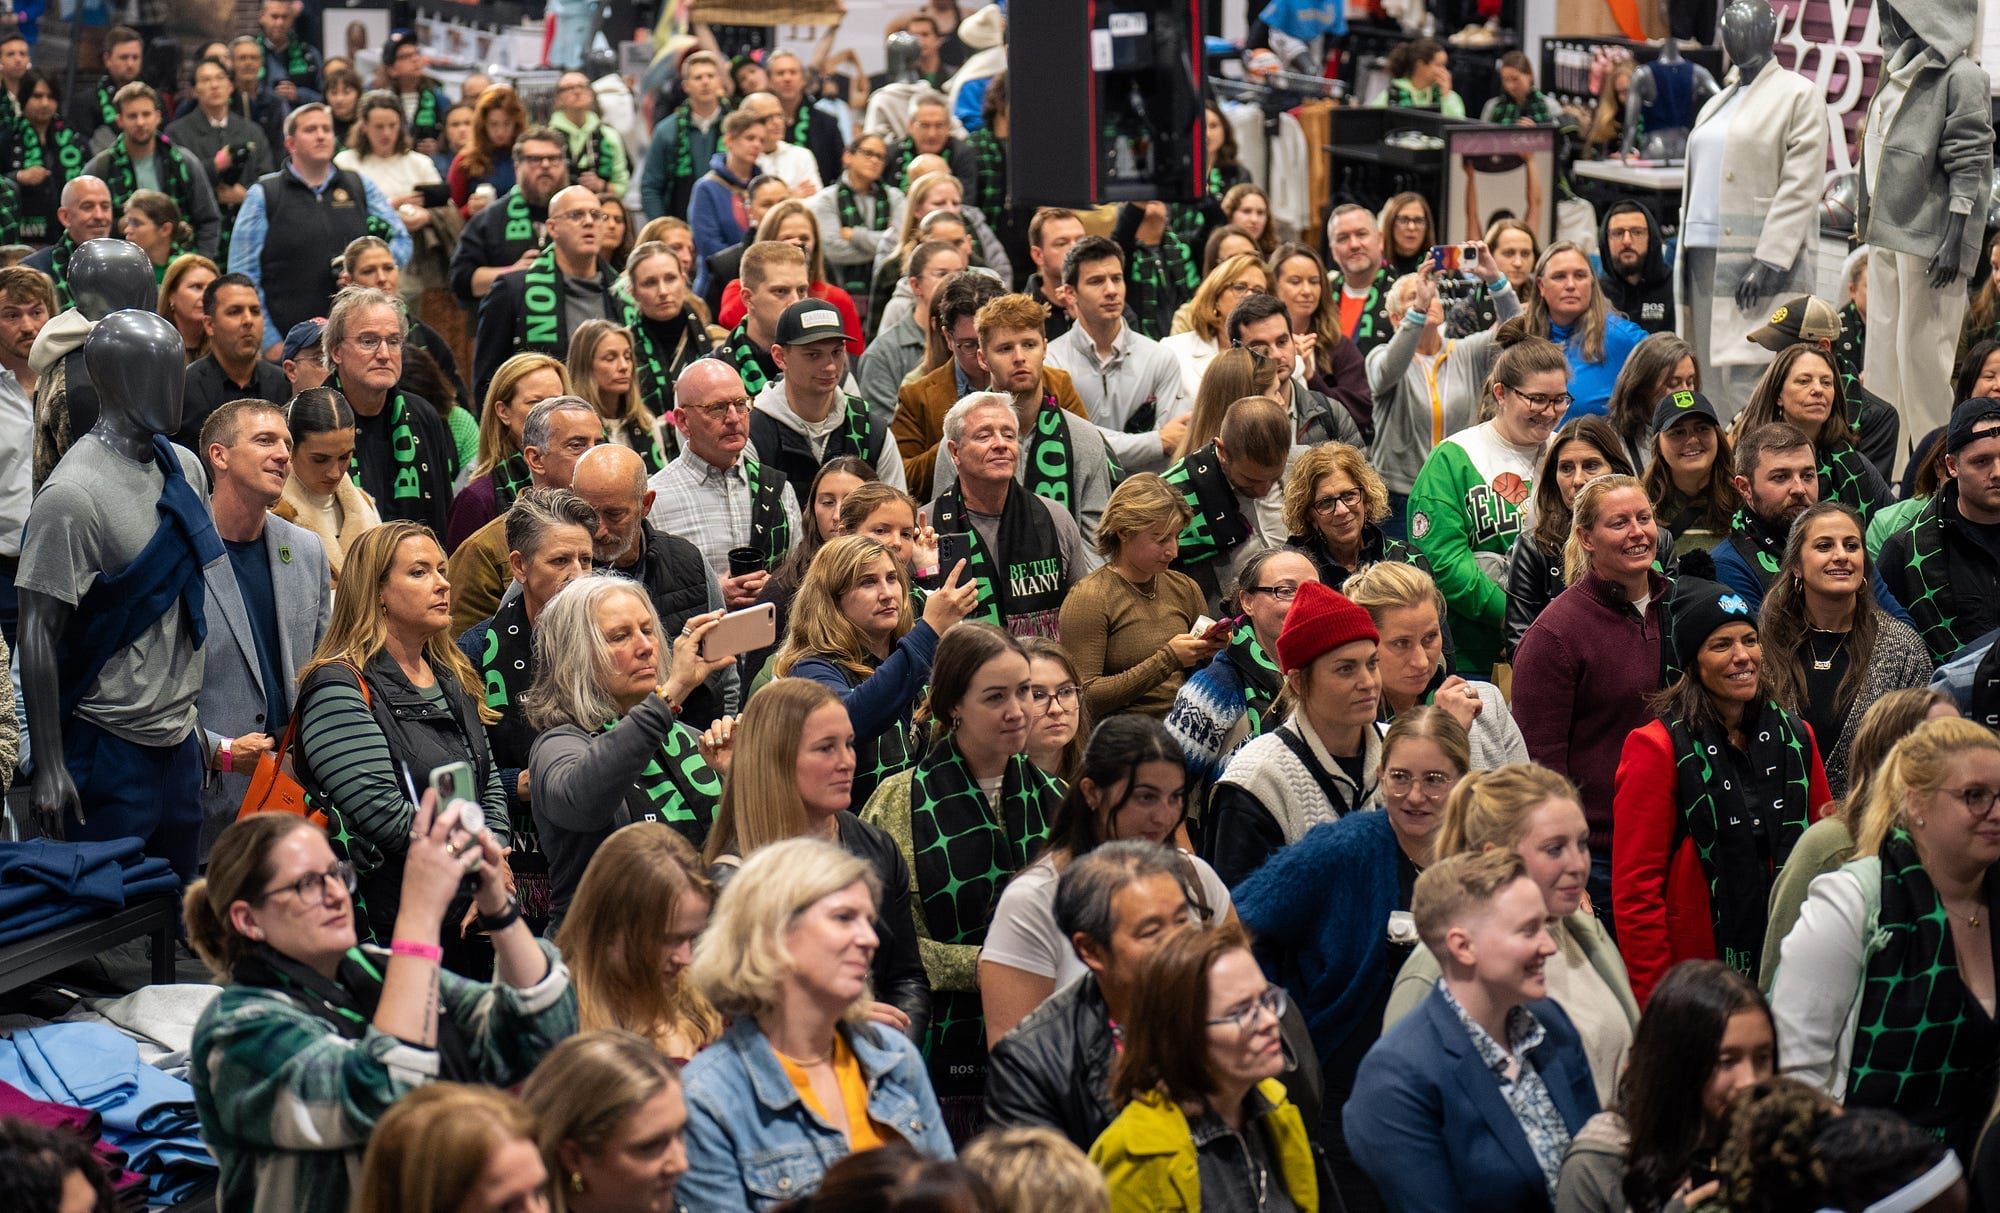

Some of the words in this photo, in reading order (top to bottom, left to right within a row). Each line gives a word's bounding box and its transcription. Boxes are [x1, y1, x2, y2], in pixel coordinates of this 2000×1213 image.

[505, 185, 532, 241] BO
[1642, 303, 1665, 312] BOS
[1035, 410, 1070, 510] BOS
[1009, 563, 1029, 580] BE
[1031, 558, 1058, 577] THE
[1010, 572, 1060, 597] MANY
